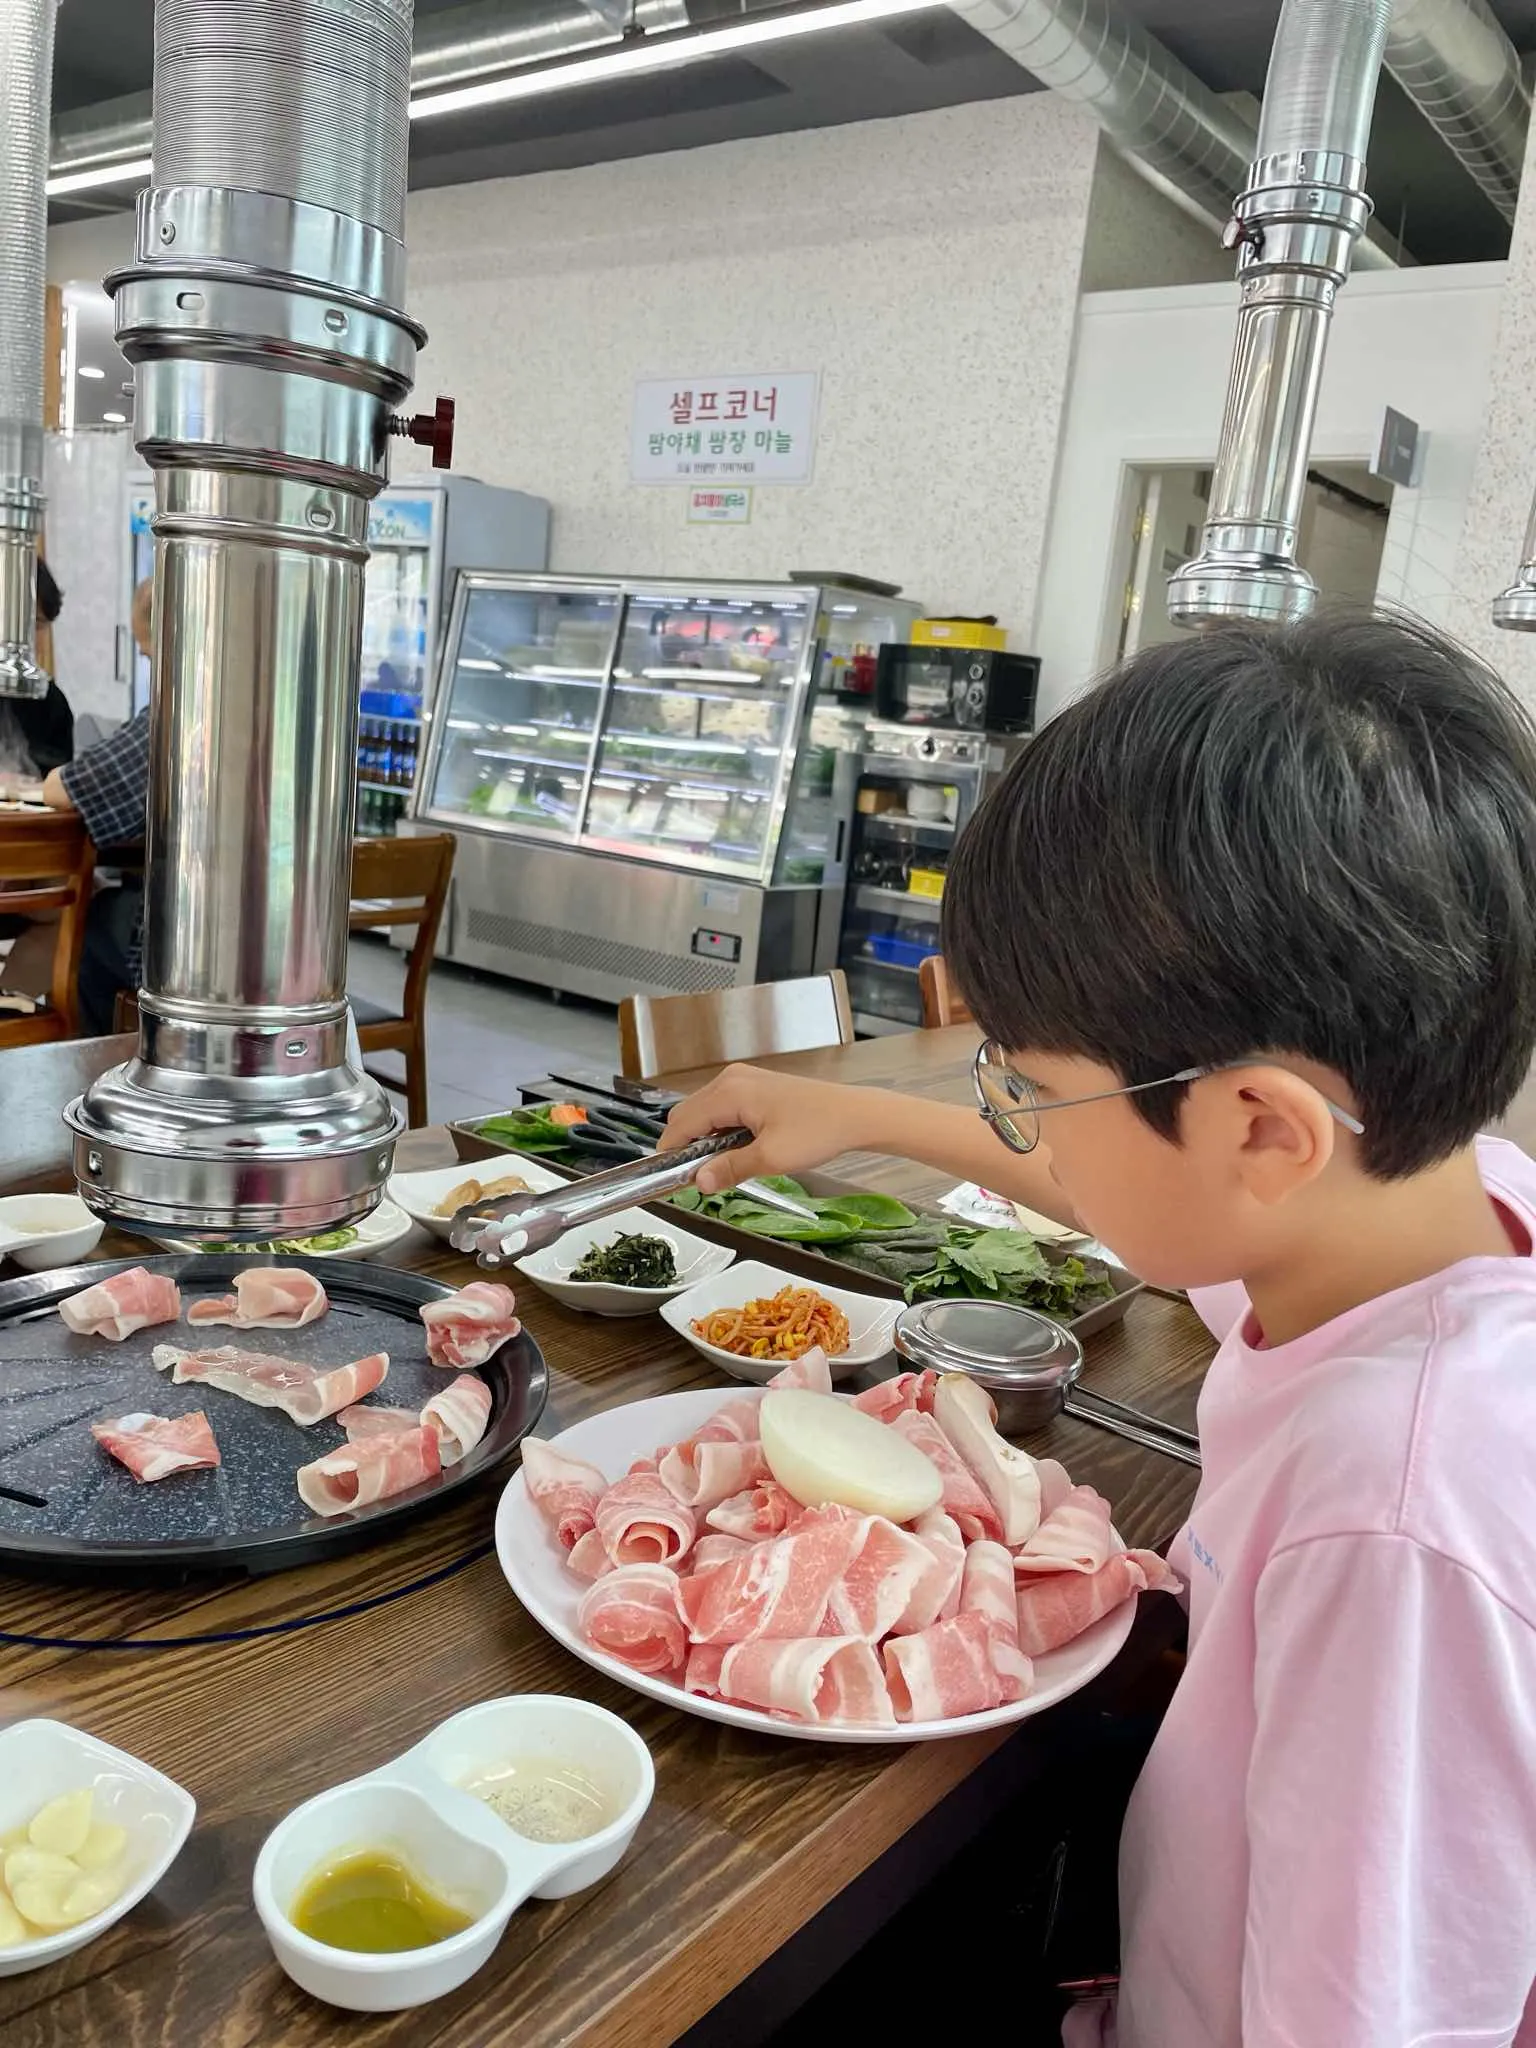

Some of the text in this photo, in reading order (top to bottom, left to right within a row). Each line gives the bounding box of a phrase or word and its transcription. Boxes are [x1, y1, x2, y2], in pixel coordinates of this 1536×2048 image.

[670, 387, 777, 424] 셀프코너
[708, 430, 746, 455] 쌈장
[754, 429, 793, 454] 마늘
